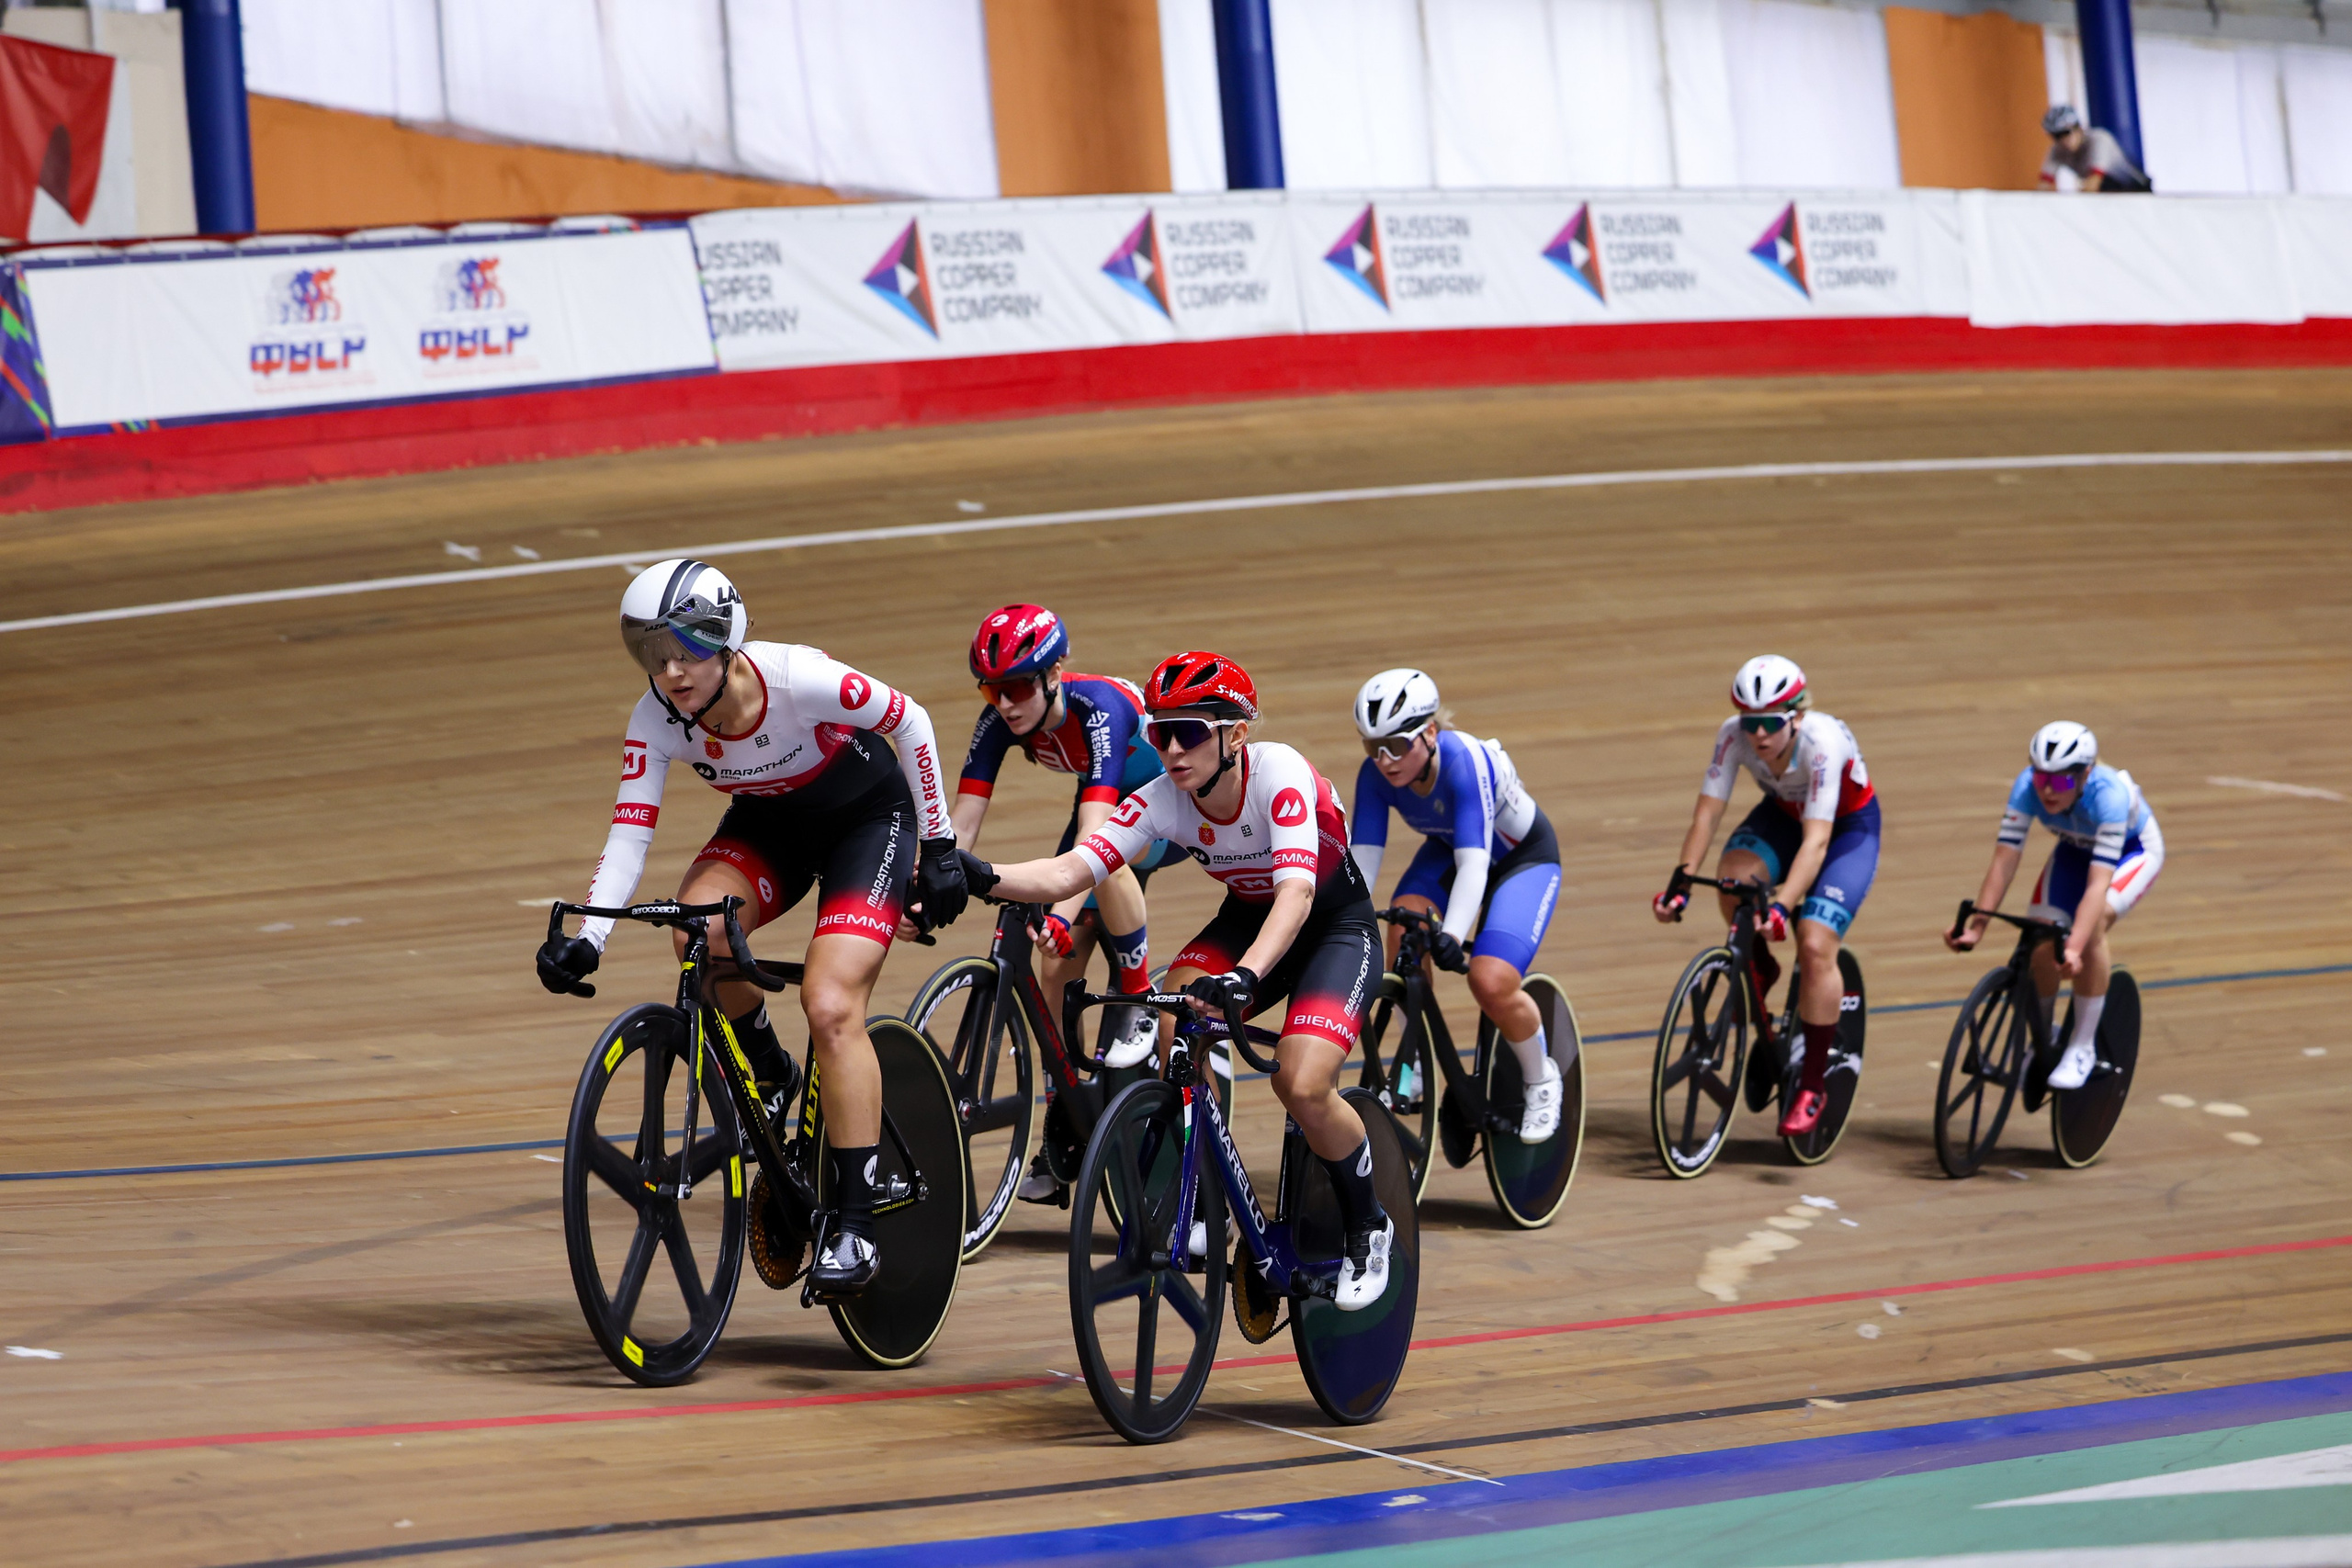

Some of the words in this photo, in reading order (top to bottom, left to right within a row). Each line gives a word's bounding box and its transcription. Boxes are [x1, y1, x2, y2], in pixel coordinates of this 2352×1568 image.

[1166, 220, 1255, 247] RUSSIAN
[1385, 215, 1471, 238] RUSSIAN
[1600, 213, 1683, 236] RUSSIAN
[1806, 212, 1885, 234] RUSSIAN
[930, 229, 1025, 258] RUSSIAN
[1391, 244, 1461, 268] COPPER
[1607, 242, 1676, 265] COPPER
[1811, 240, 1879, 262] COPPER
[937, 262, 1015, 291] COPPER
[1171, 250, 1247, 279] COPPER
[1815, 267, 1896, 289] COMPANY
[1177, 279, 1269, 310] COMPANY
[1396, 274, 1486, 299] COMPANY
[1611, 269, 1697, 294] COMPANY
[943, 292, 1043, 323] COMPANY
[1034, 629, 1062, 662] ESSEN
[1214, 683, 1258, 716] S-WORKS
[1090, 729, 1102, 781] RESHENIE
[1100, 726, 1112, 758] BANK
[719, 744, 804, 777] MARATHON
[914, 742, 938, 802] REGION
[927, 803, 942, 838] TULA
[876, 891, 888, 911] CYCLING
[885, 876, 894, 892] TEAM
[631, 904, 681, 916] aerocoach
[818, 913, 895, 938] BIEMME
[1350, 1001, 1361, 1021] CYCLING
[1357, 991, 1365, 1004] TEAM
[715, 1019, 724, 1037] BIKE
[723, 1039, 748, 1094] TECHNOLOGIES
[746, 1096, 764, 1135] AUSTRALIA
[1204, 1088, 1266, 1235] PINARELLO
